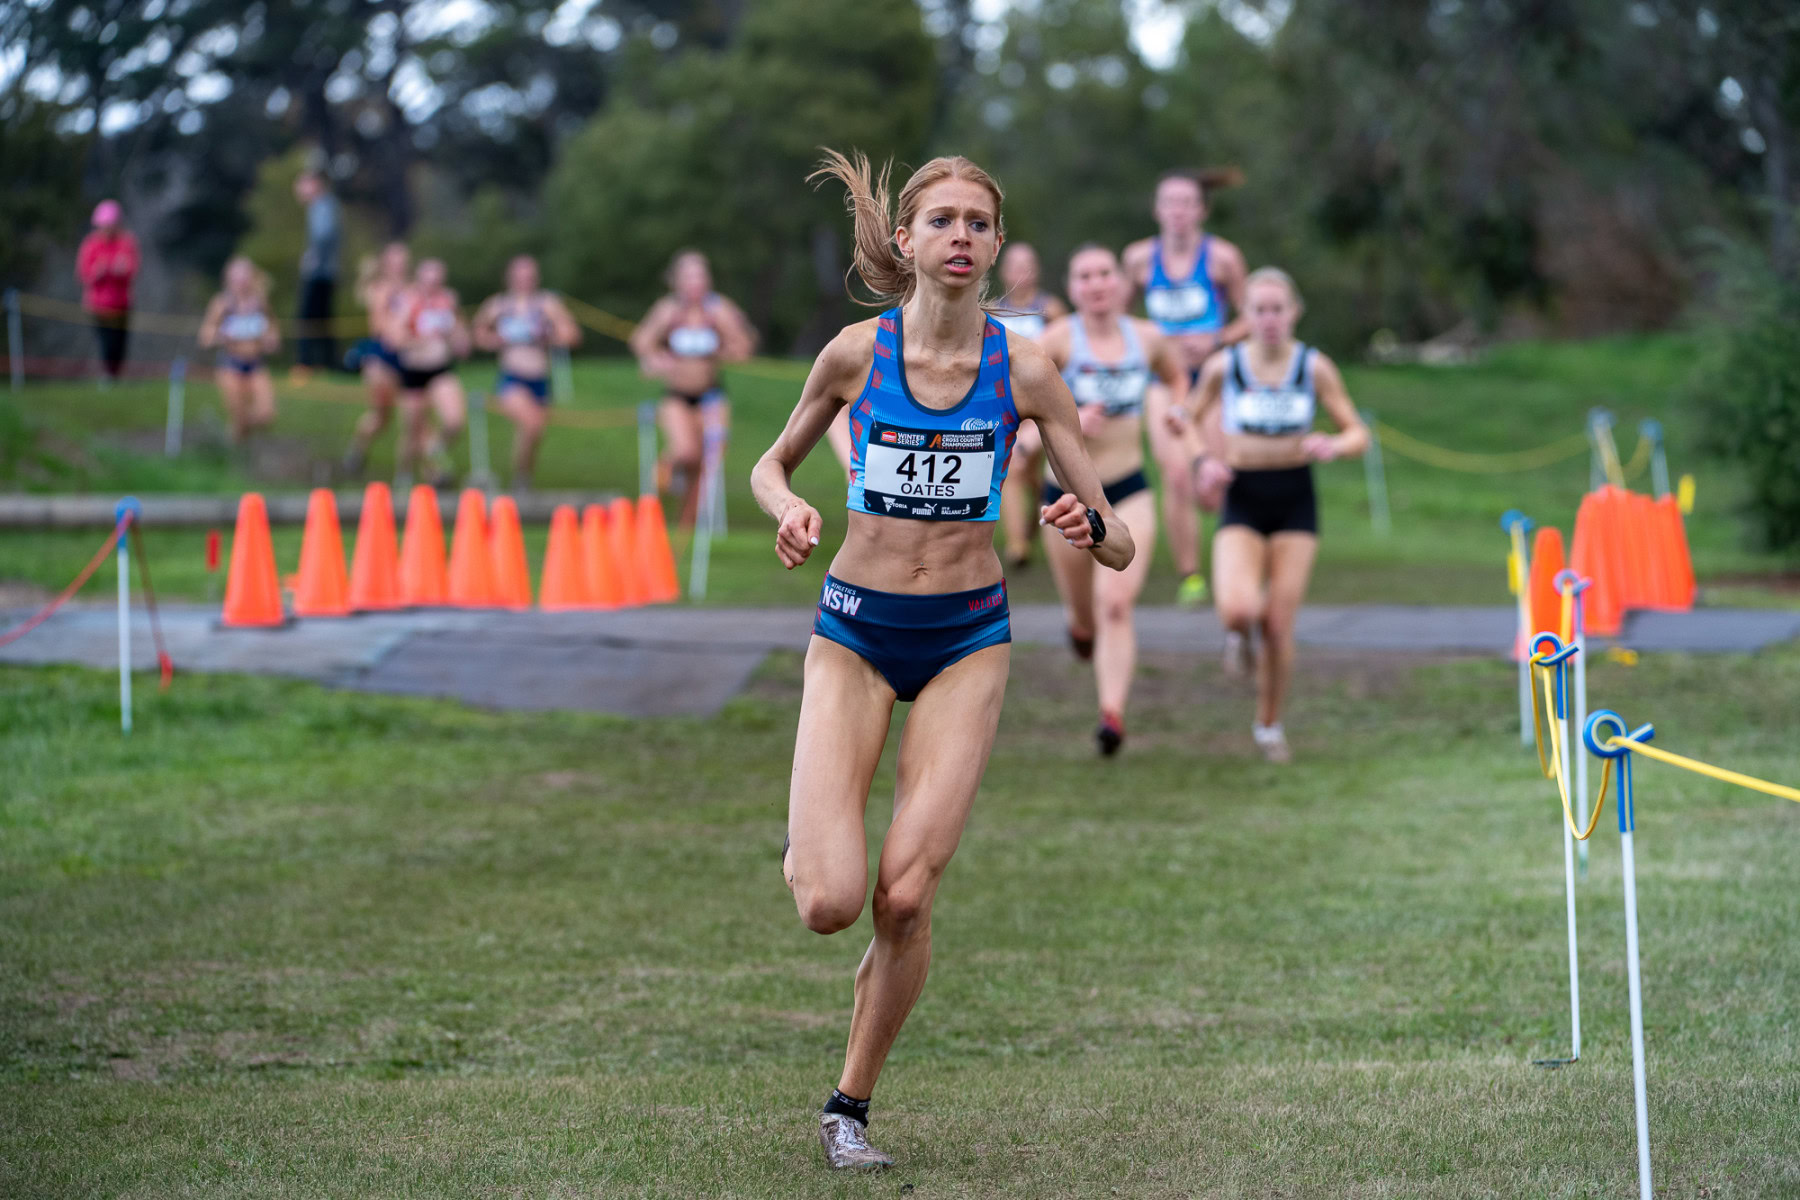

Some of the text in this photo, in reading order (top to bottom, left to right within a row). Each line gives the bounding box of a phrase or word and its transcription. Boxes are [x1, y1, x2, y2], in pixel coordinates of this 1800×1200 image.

[897, 432, 925, 441] WINTER
[897, 438, 920, 446] SERIES
[896, 453, 961, 483] 412
[901, 483, 955, 496] OATES
[912, 508, 932, 516] PUMA
[831, 582, 857, 596] ATHLETICS
[822, 585, 862, 616] NSW
[968, 593, 1003, 611] VALOUR
